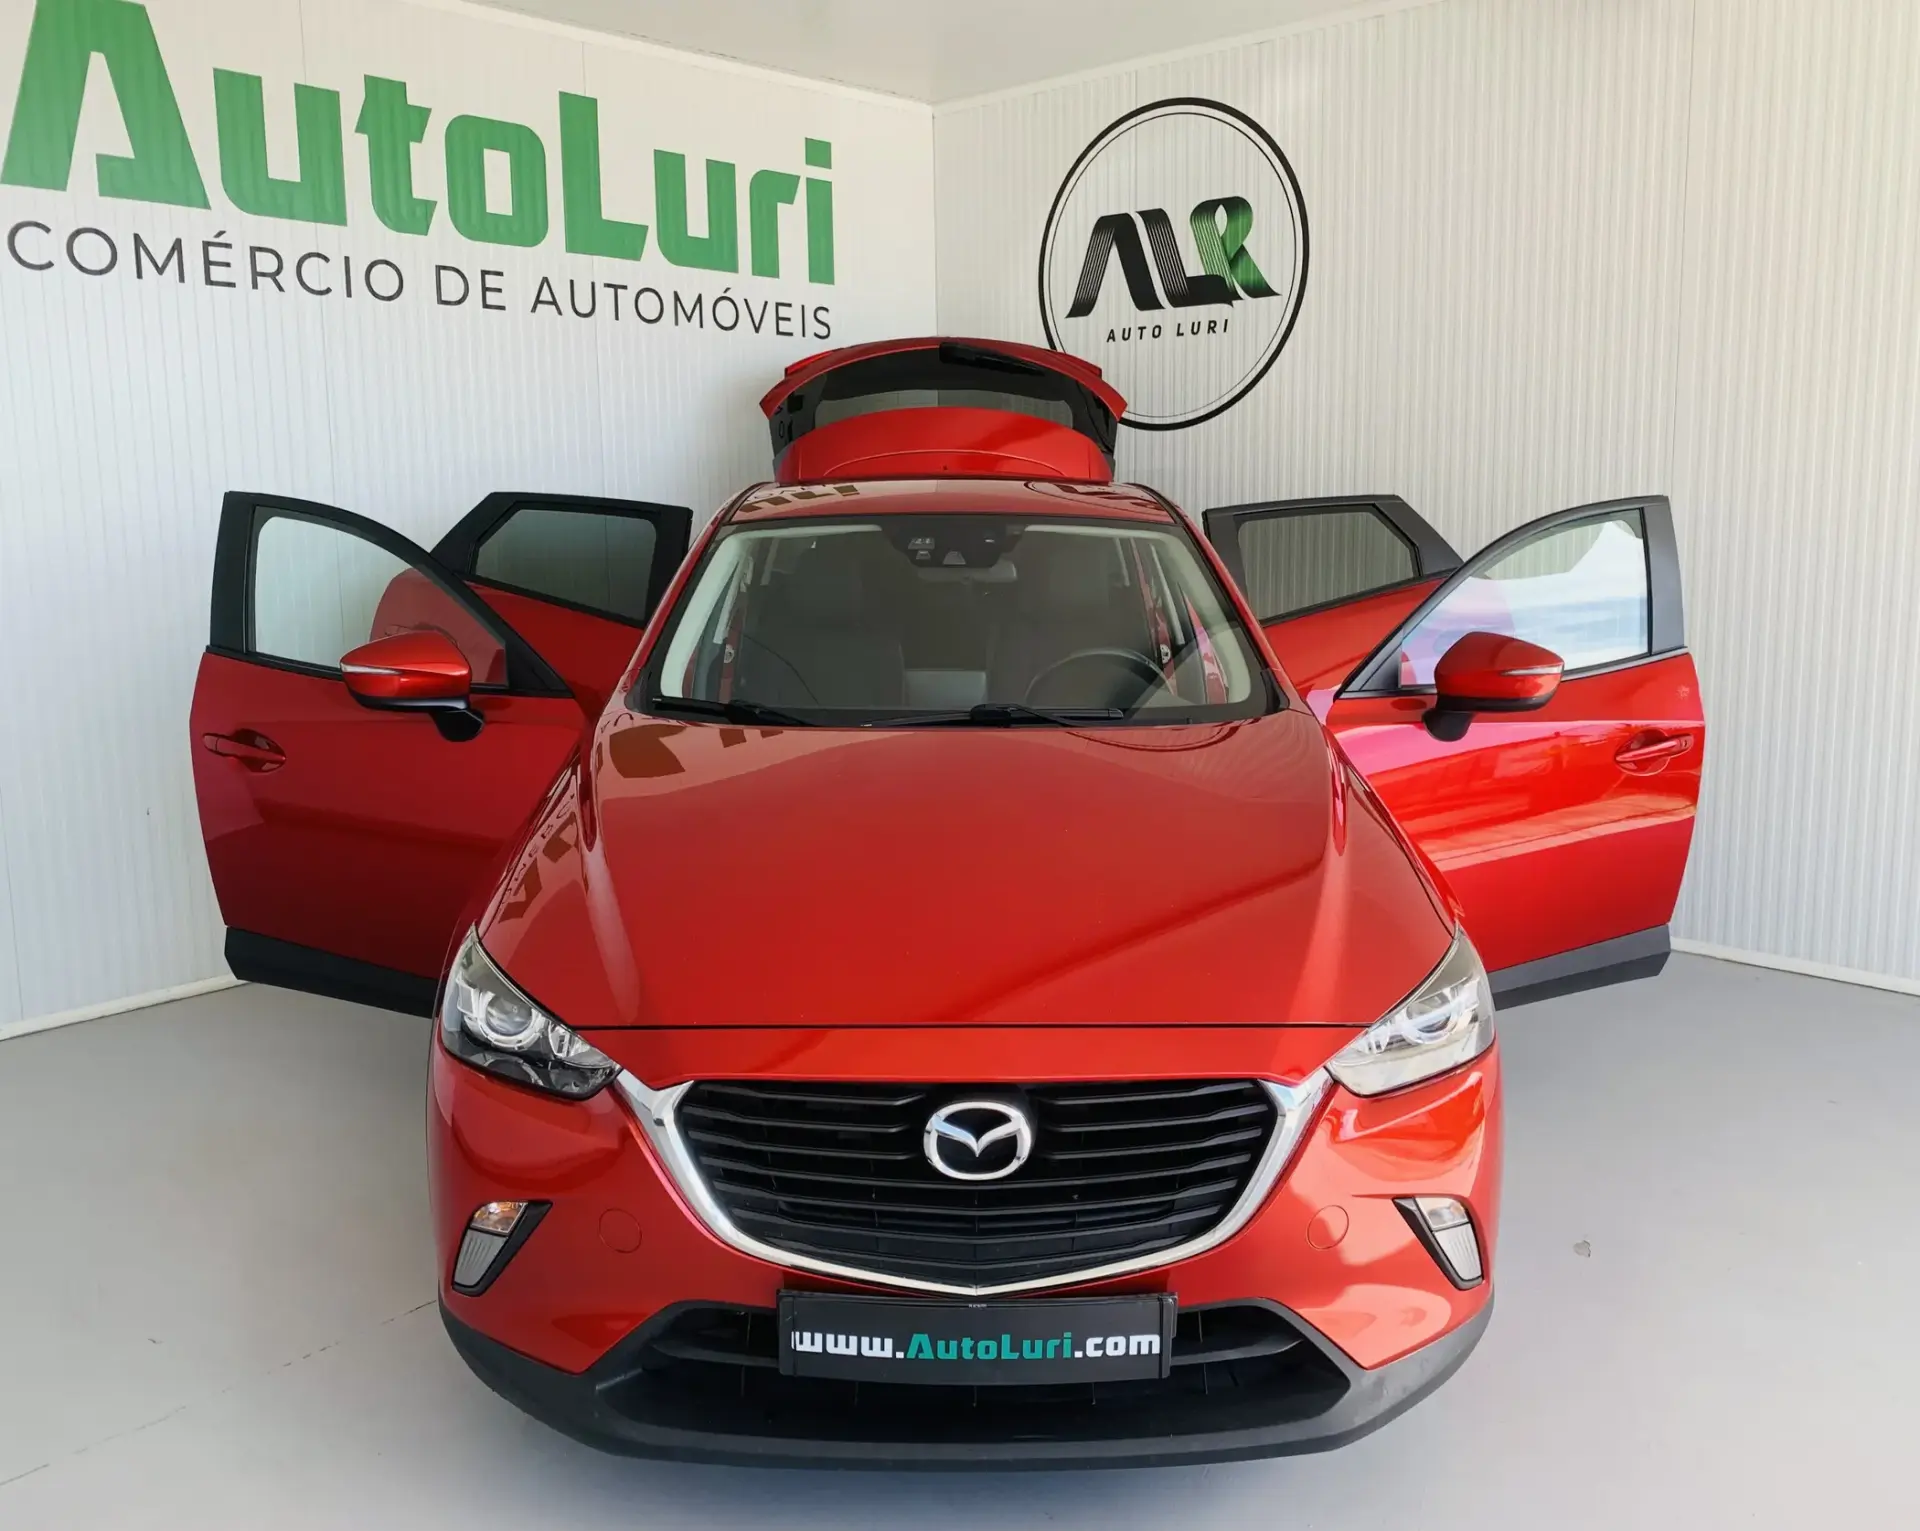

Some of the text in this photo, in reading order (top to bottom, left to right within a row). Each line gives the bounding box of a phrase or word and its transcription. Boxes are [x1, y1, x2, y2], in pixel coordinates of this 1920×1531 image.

[0, 0, 835, 285] AutoLuri
[7, 220, 832, 340] COMÉRCIO DE AUTOMÓVEIS
[1106, 318, 1229, 343] AUTO LURI
[791, 1331, 1161, 1360] www.AutoLuri.com
